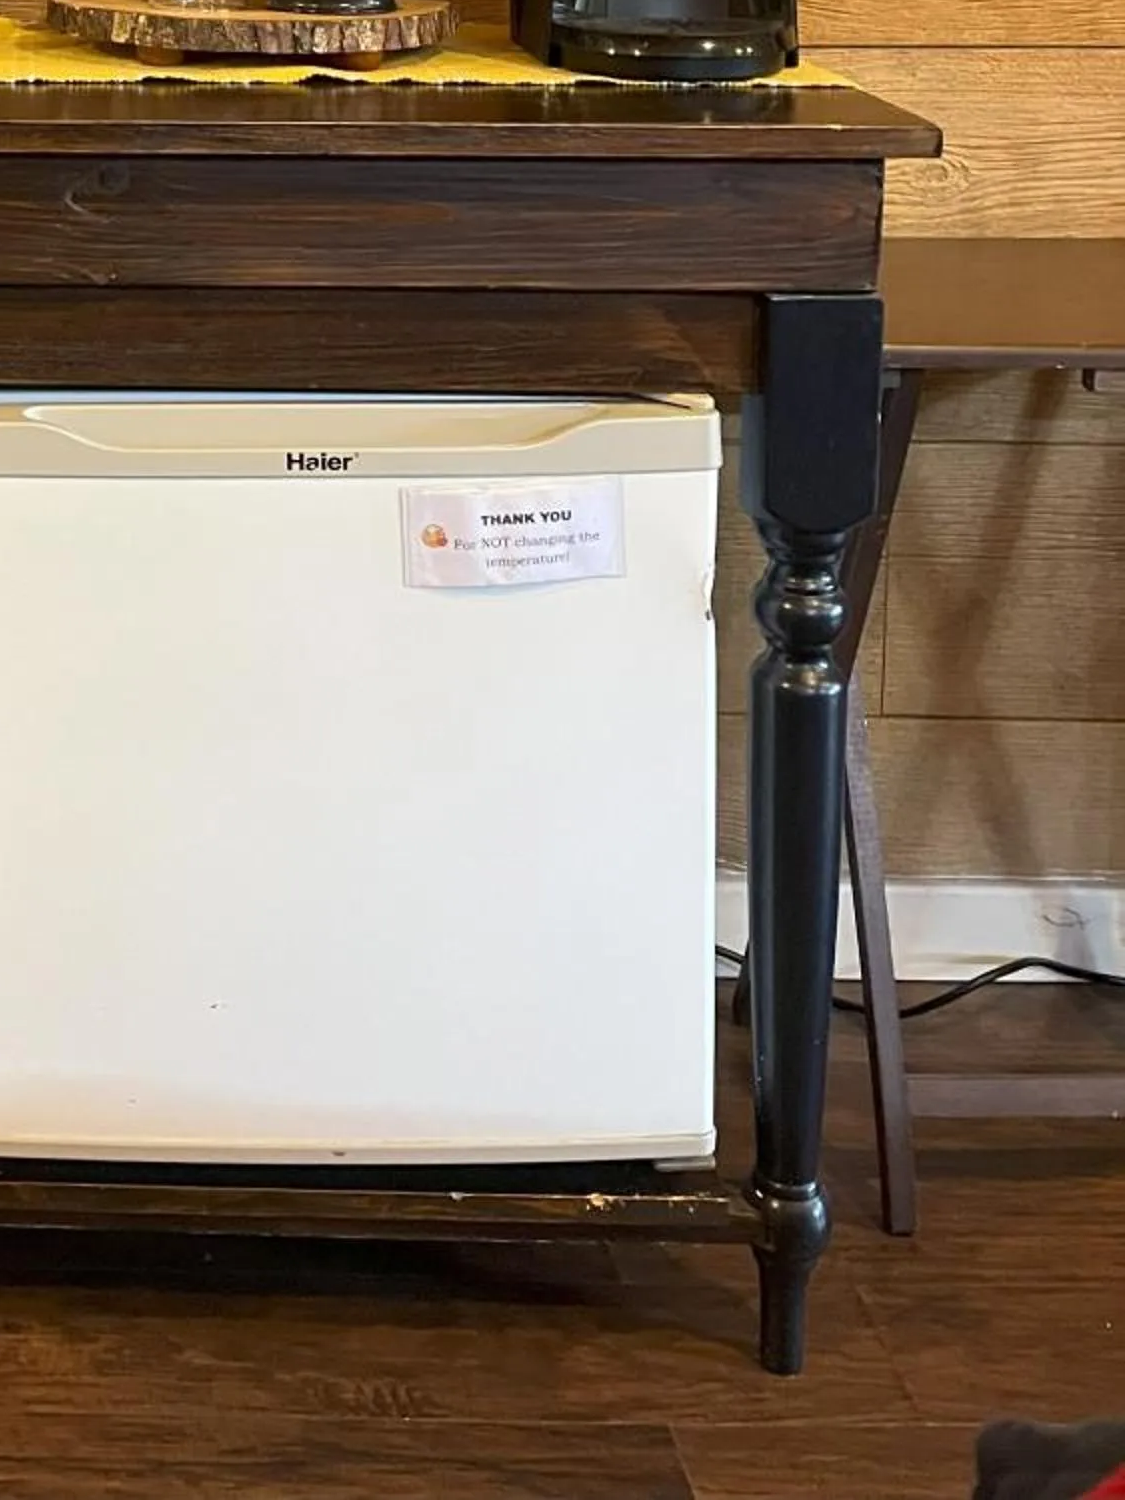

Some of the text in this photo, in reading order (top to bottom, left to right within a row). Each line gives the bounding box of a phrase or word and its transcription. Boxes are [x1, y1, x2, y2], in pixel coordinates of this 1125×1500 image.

[285, 453, 355, 471] Haier
[480, 509, 572, 526] THANK YOU
[481, 536, 511, 549] NOT
[514, 533, 576, 550] changing
[578, 531, 601, 543] the
